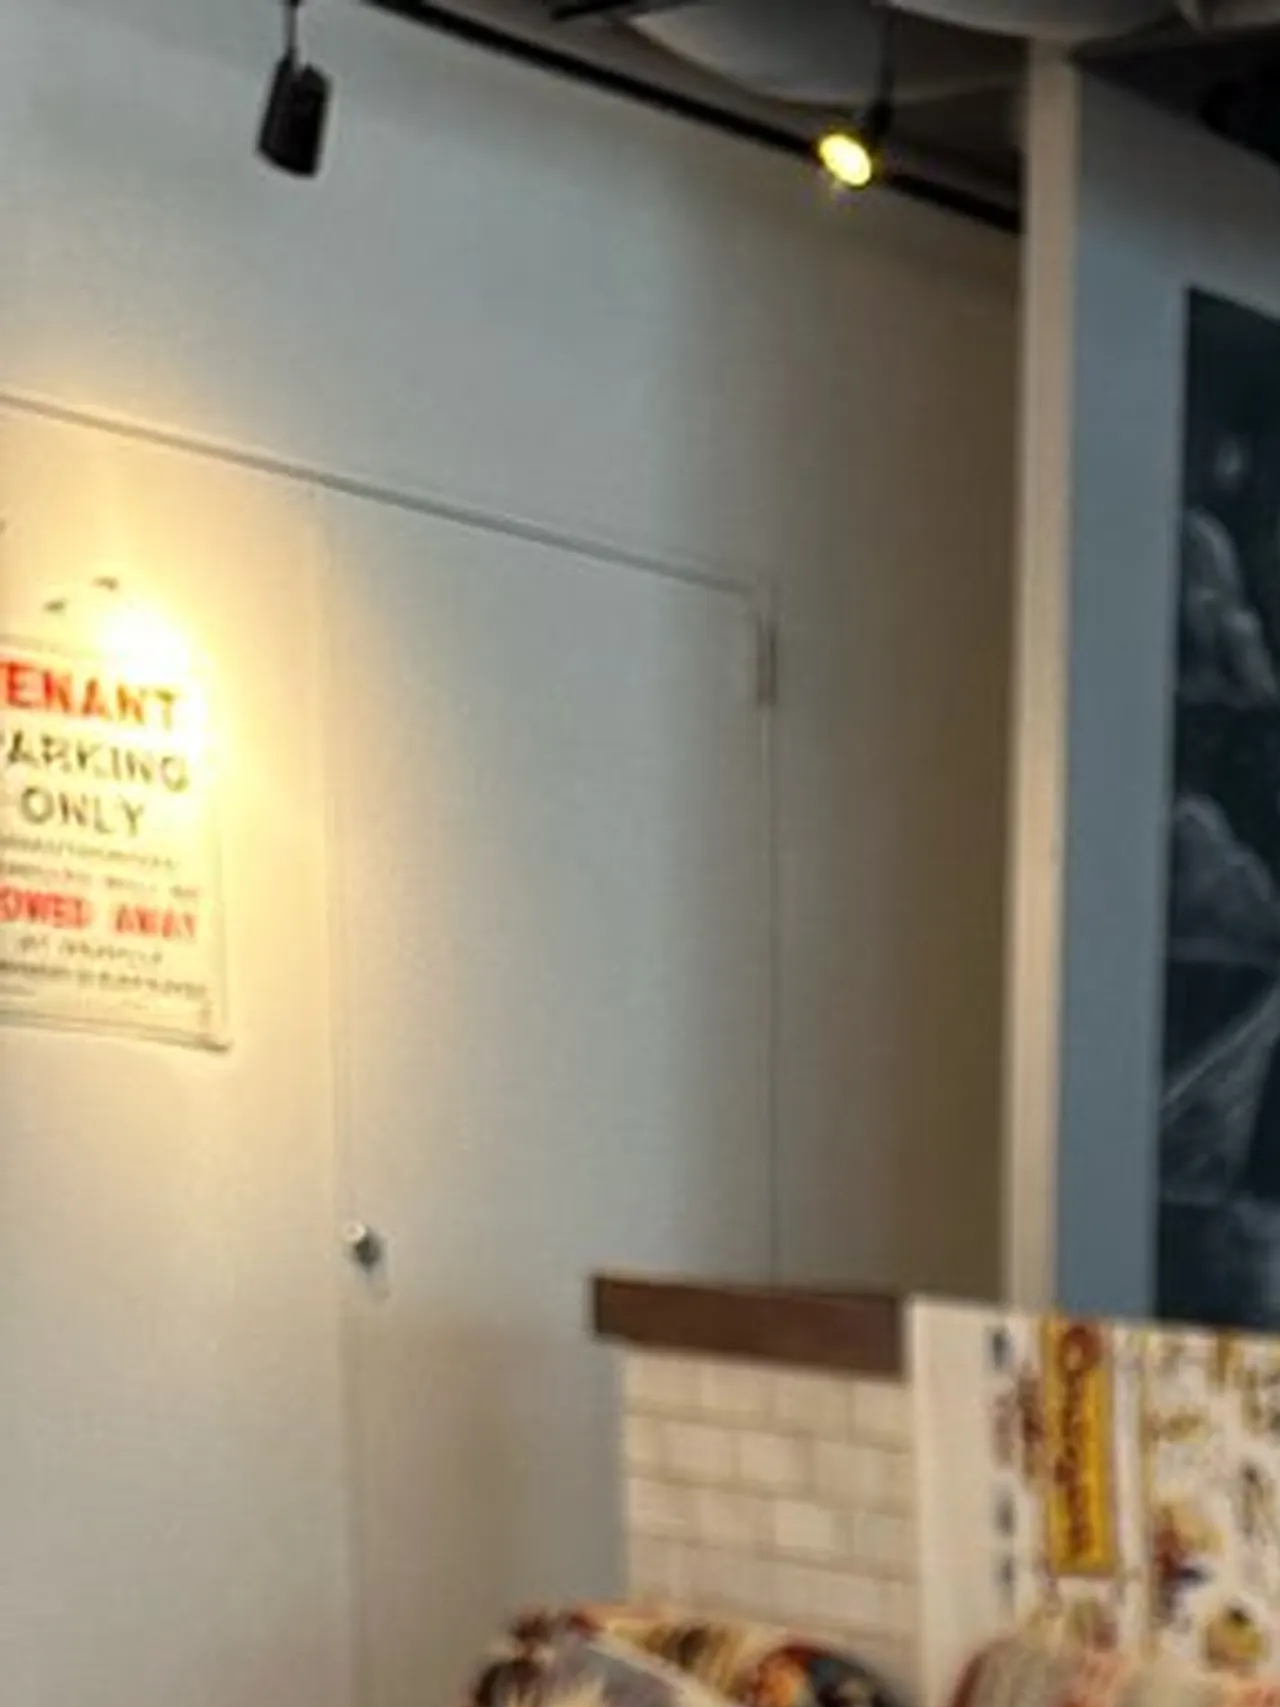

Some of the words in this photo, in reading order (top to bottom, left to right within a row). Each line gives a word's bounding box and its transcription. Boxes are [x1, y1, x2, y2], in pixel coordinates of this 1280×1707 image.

[0, 660, 177, 732] ENANT
[0, 729, 190, 793] ARKING
[20, 785, 145, 838] ONLY
